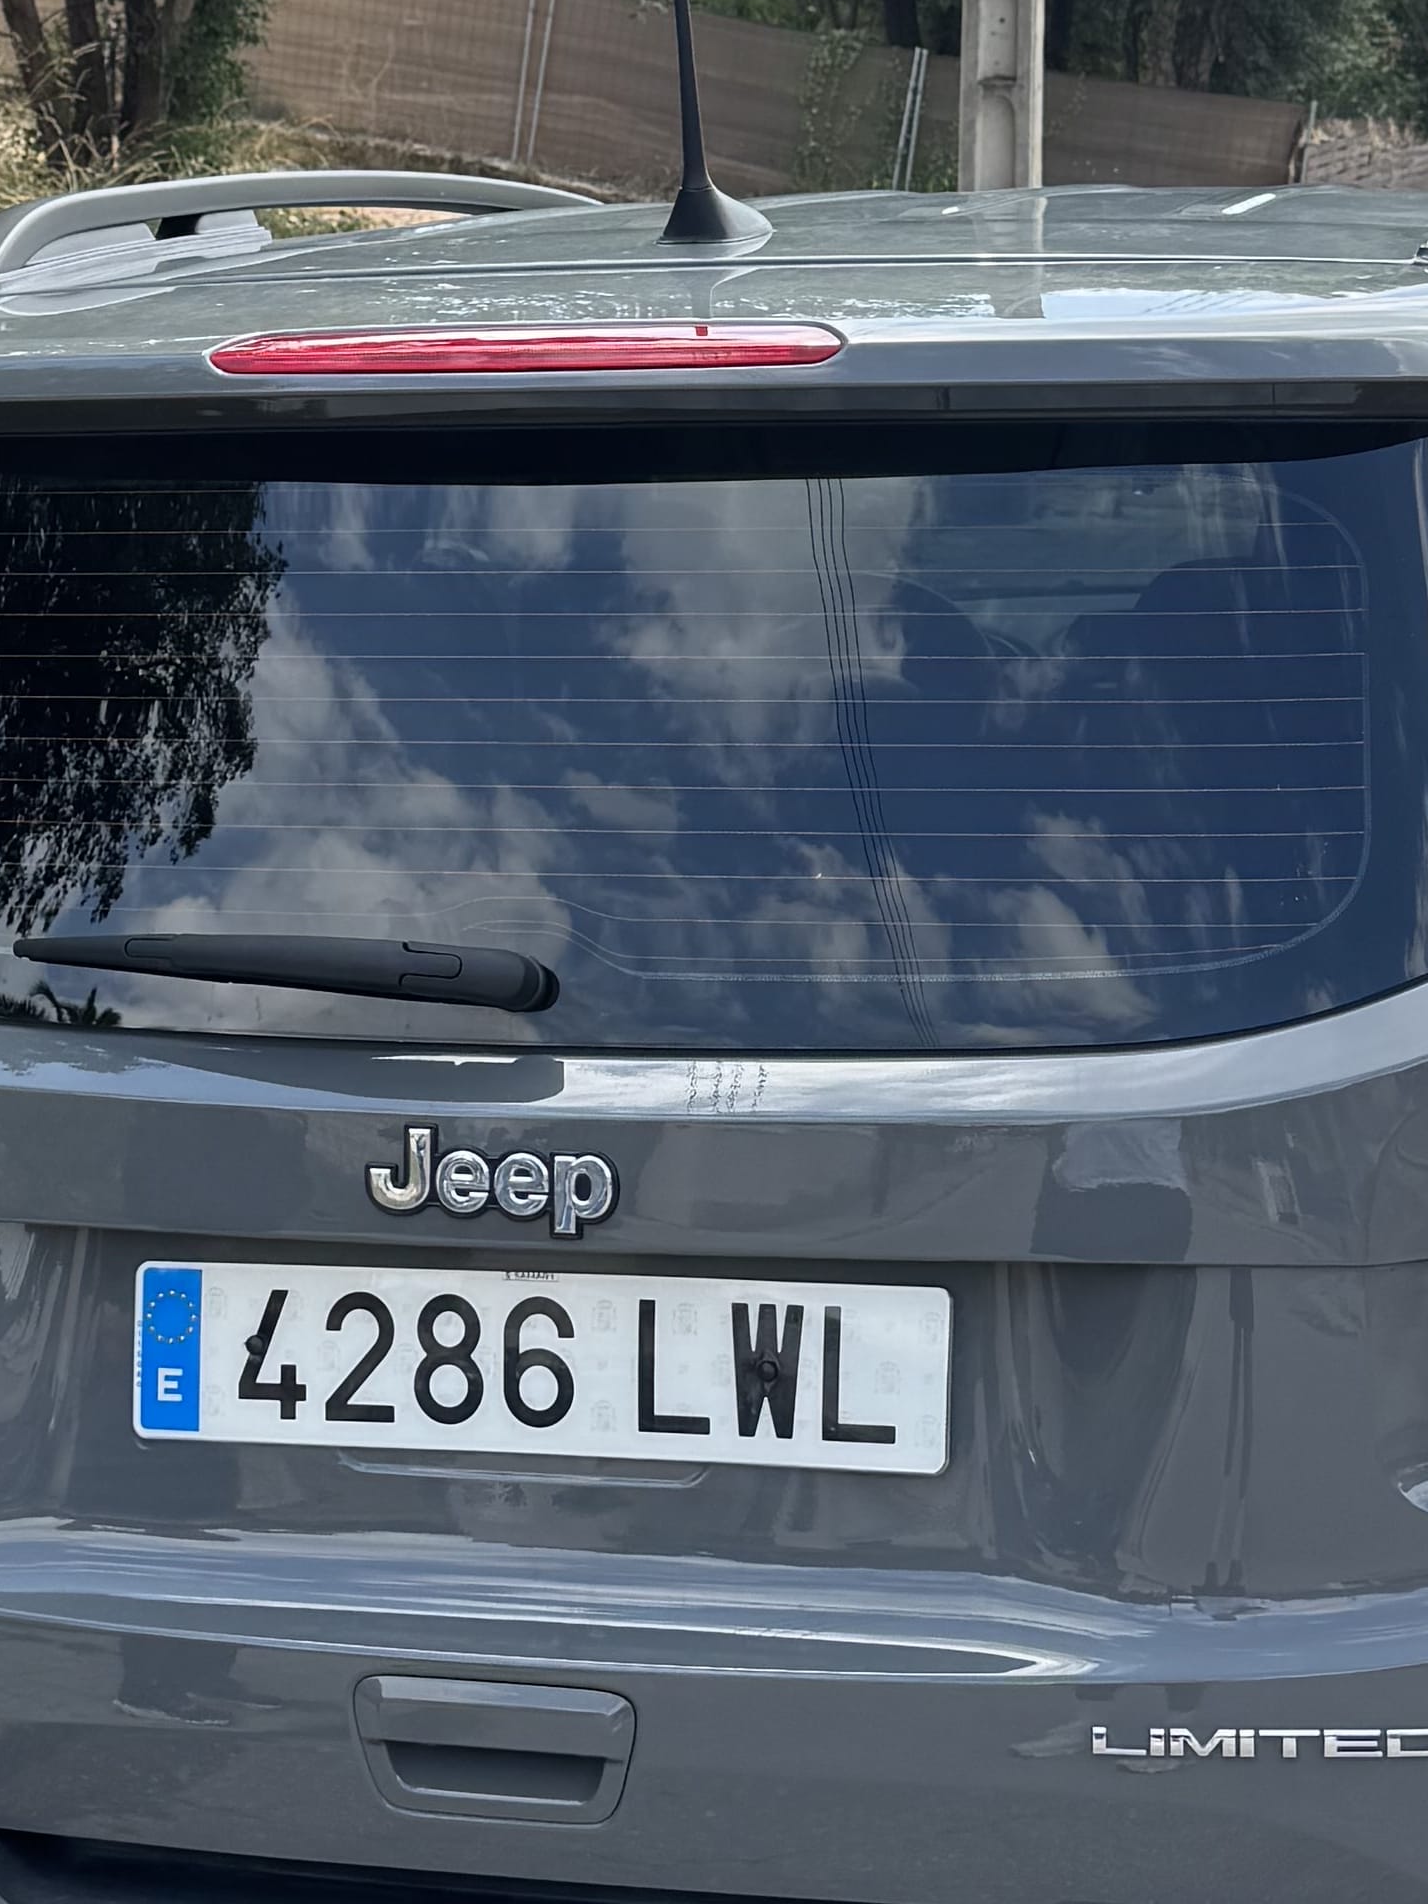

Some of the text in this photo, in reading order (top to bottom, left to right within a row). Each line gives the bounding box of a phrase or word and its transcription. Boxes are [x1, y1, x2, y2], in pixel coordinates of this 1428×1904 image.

[369, 1127, 616, 1234] Jeep
[157, 1367, 183, 1402] E
[238, 1289, 575, 1428] 4286
[638, 1299, 897, 1444] LWL
